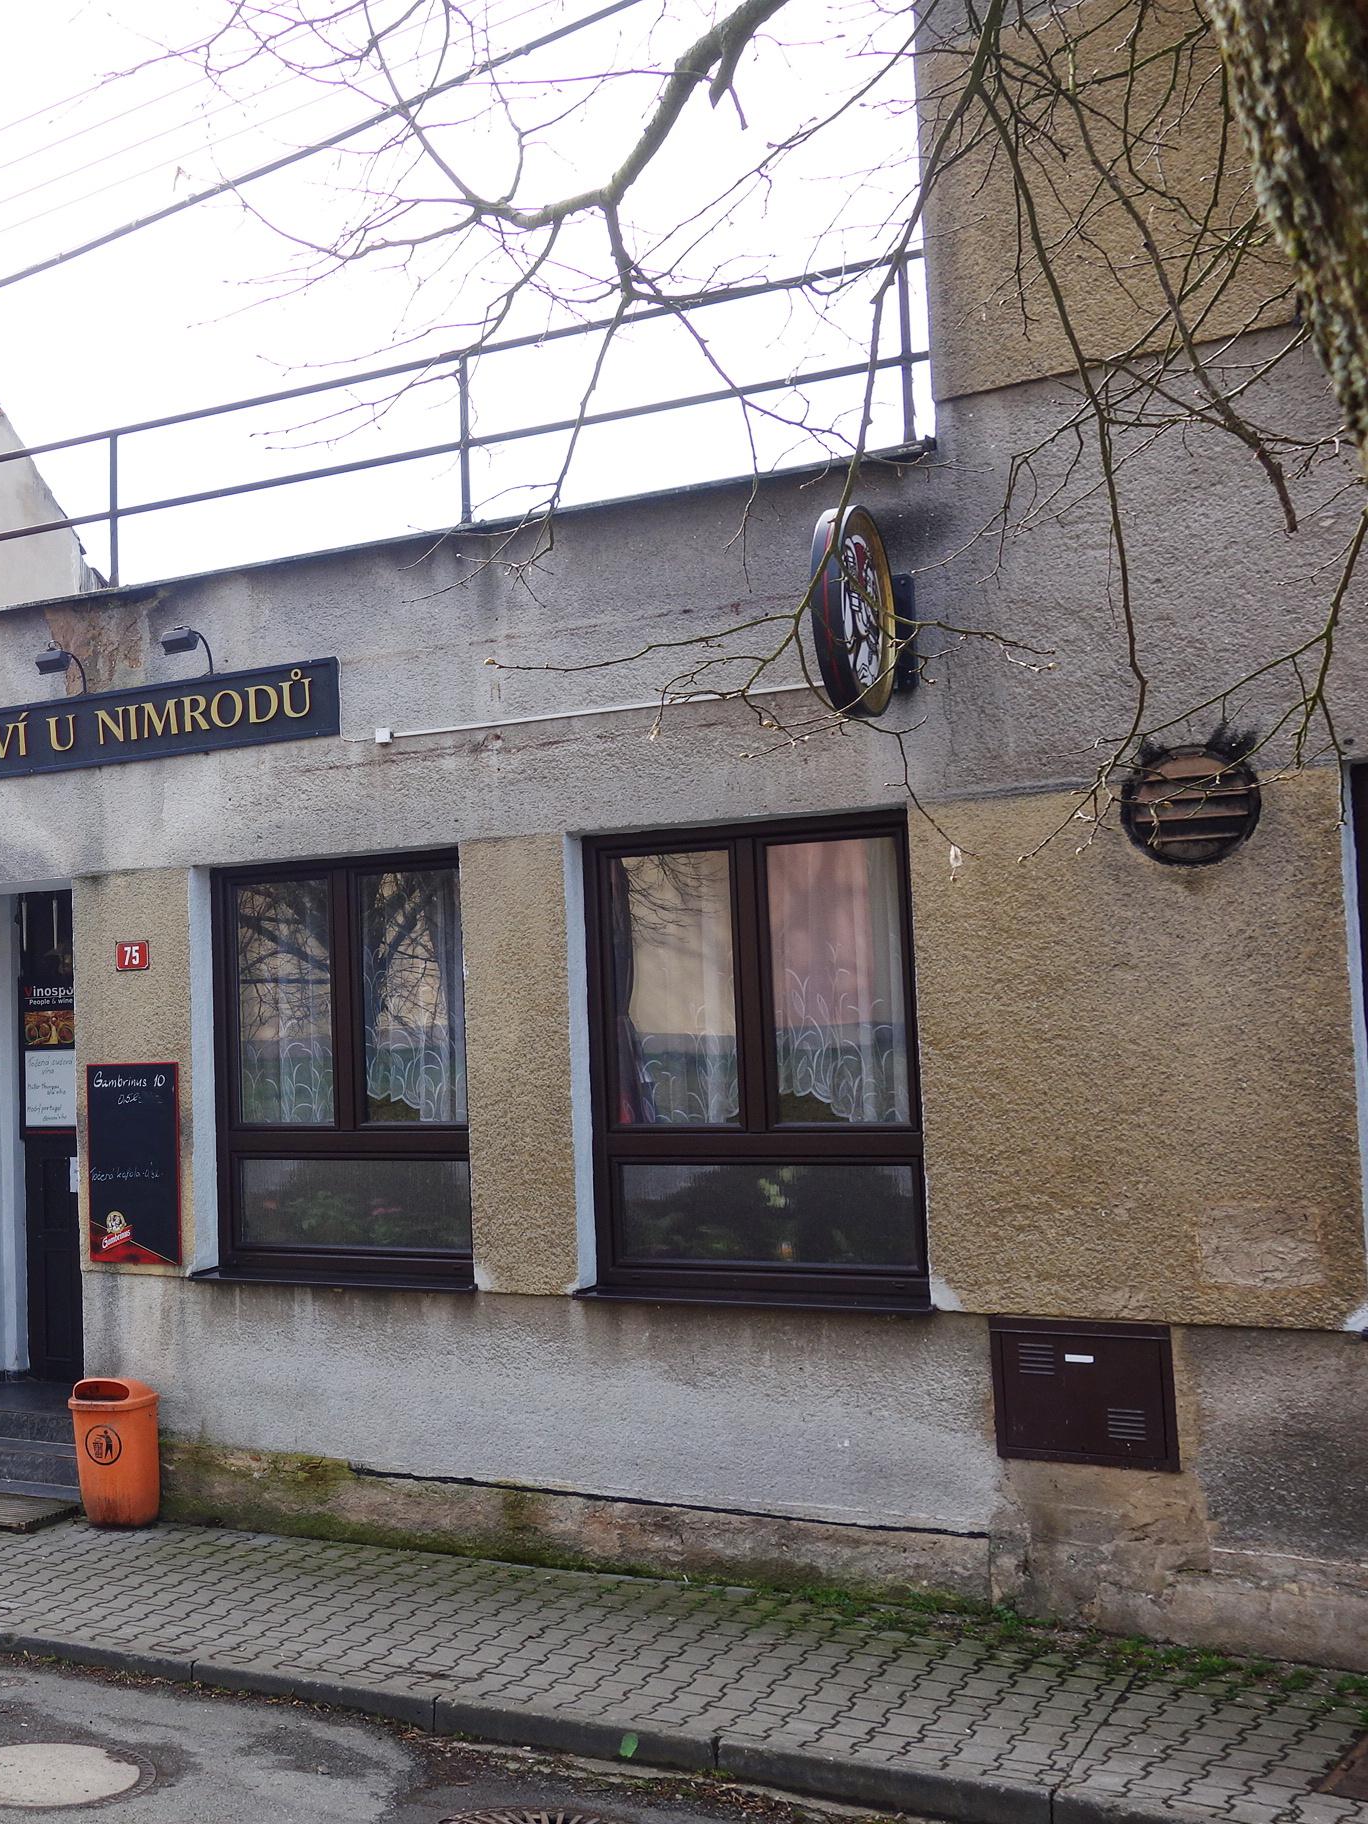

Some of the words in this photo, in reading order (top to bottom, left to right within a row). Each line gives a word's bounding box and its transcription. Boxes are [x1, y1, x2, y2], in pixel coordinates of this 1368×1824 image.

[46, 714, 76, 751] U
[94, 668, 313, 745] NIMRODŮ
[123, 946, 140, 966] 75
[29, 998, 51, 1006] People
[93, 1071, 148, 1088] Gambrinus
[153, 1074, 166, 1088] 10
